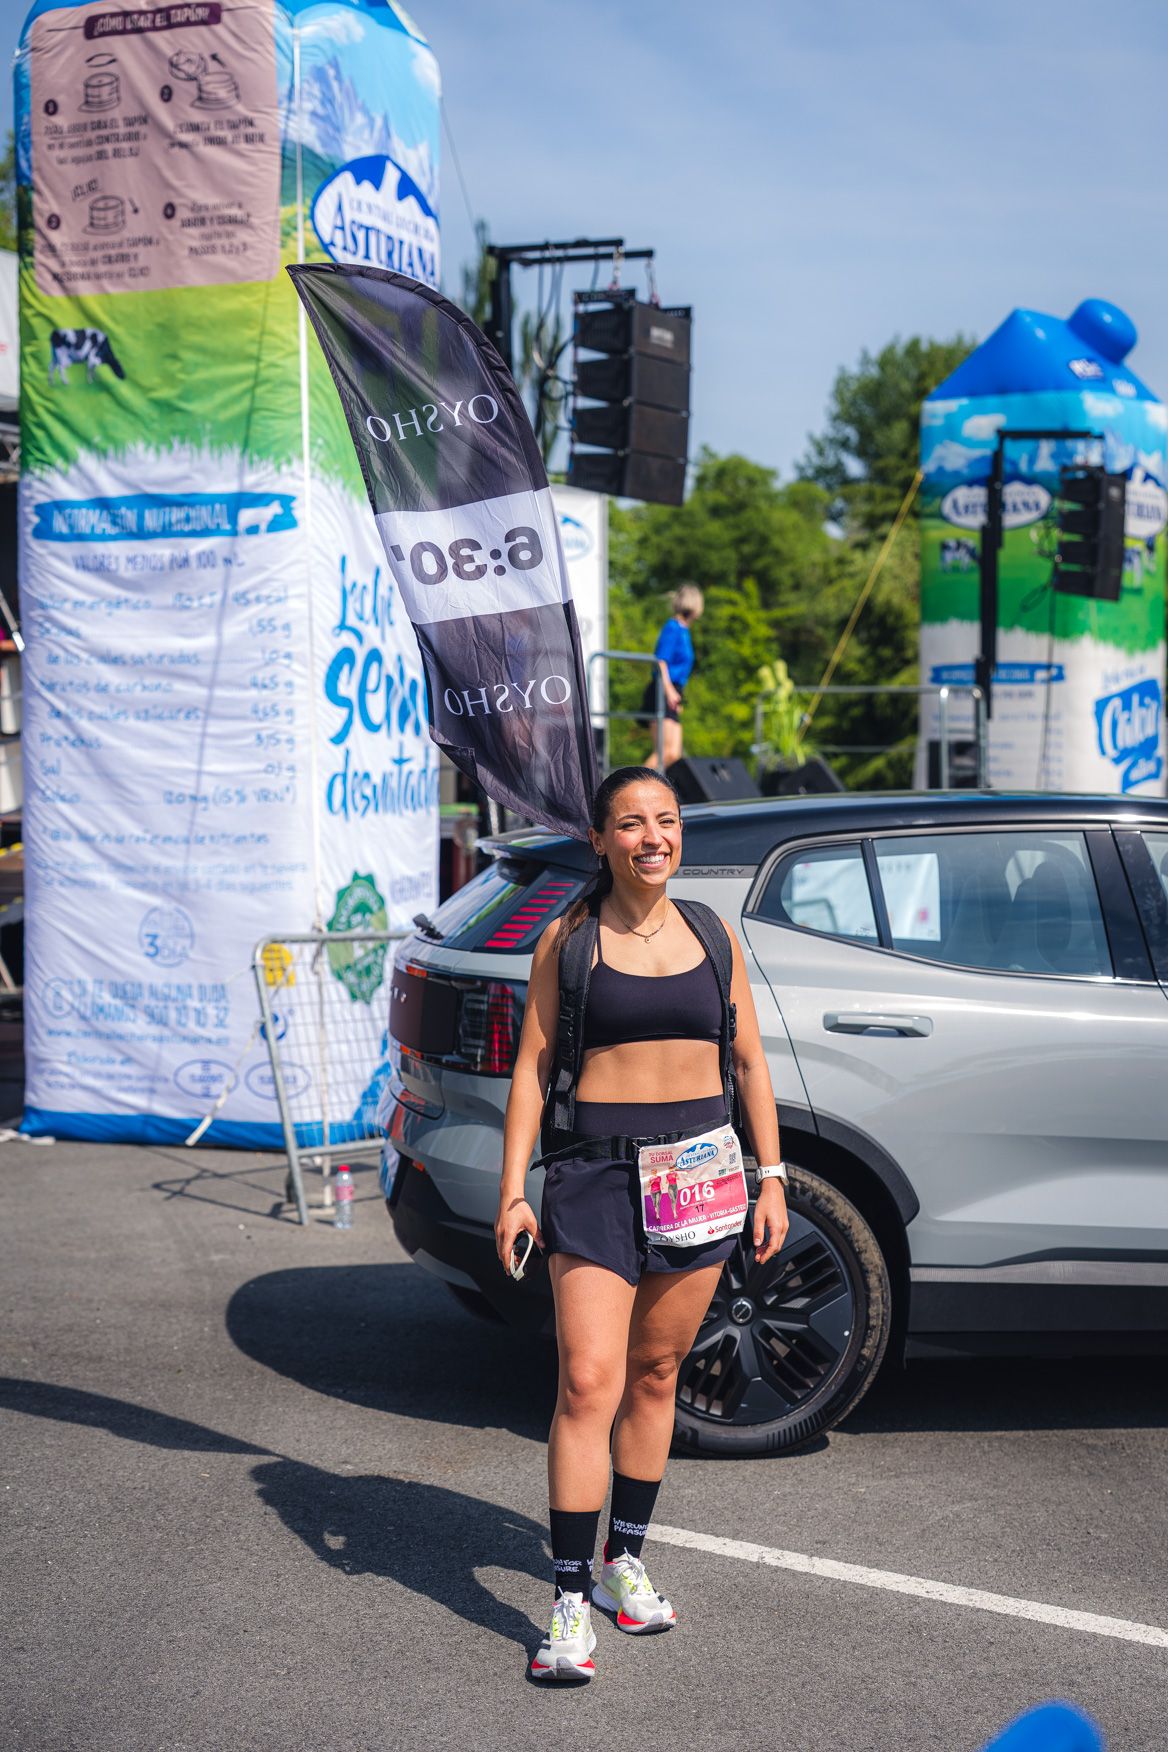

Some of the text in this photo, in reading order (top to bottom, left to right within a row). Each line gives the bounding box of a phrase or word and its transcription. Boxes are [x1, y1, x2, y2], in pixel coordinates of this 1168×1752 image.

[682, 868, 744, 876] COUNTRY
[144, 932, 160, 958] 3
[650, 1154, 673, 1164] SUMA
[680, 1150, 715, 1166] ASTURIANA
[680, 1181, 715, 1206] 016
[695, 1203, 705, 1213] 17
[648, 1223, 674, 1232] CARRERA
[674, 1221, 681, 1229] DE
[681, 1219, 688, 1227] LA
[688, 1214, 706, 1225] MUJER
[715, 1220, 742, 1232] Santander
